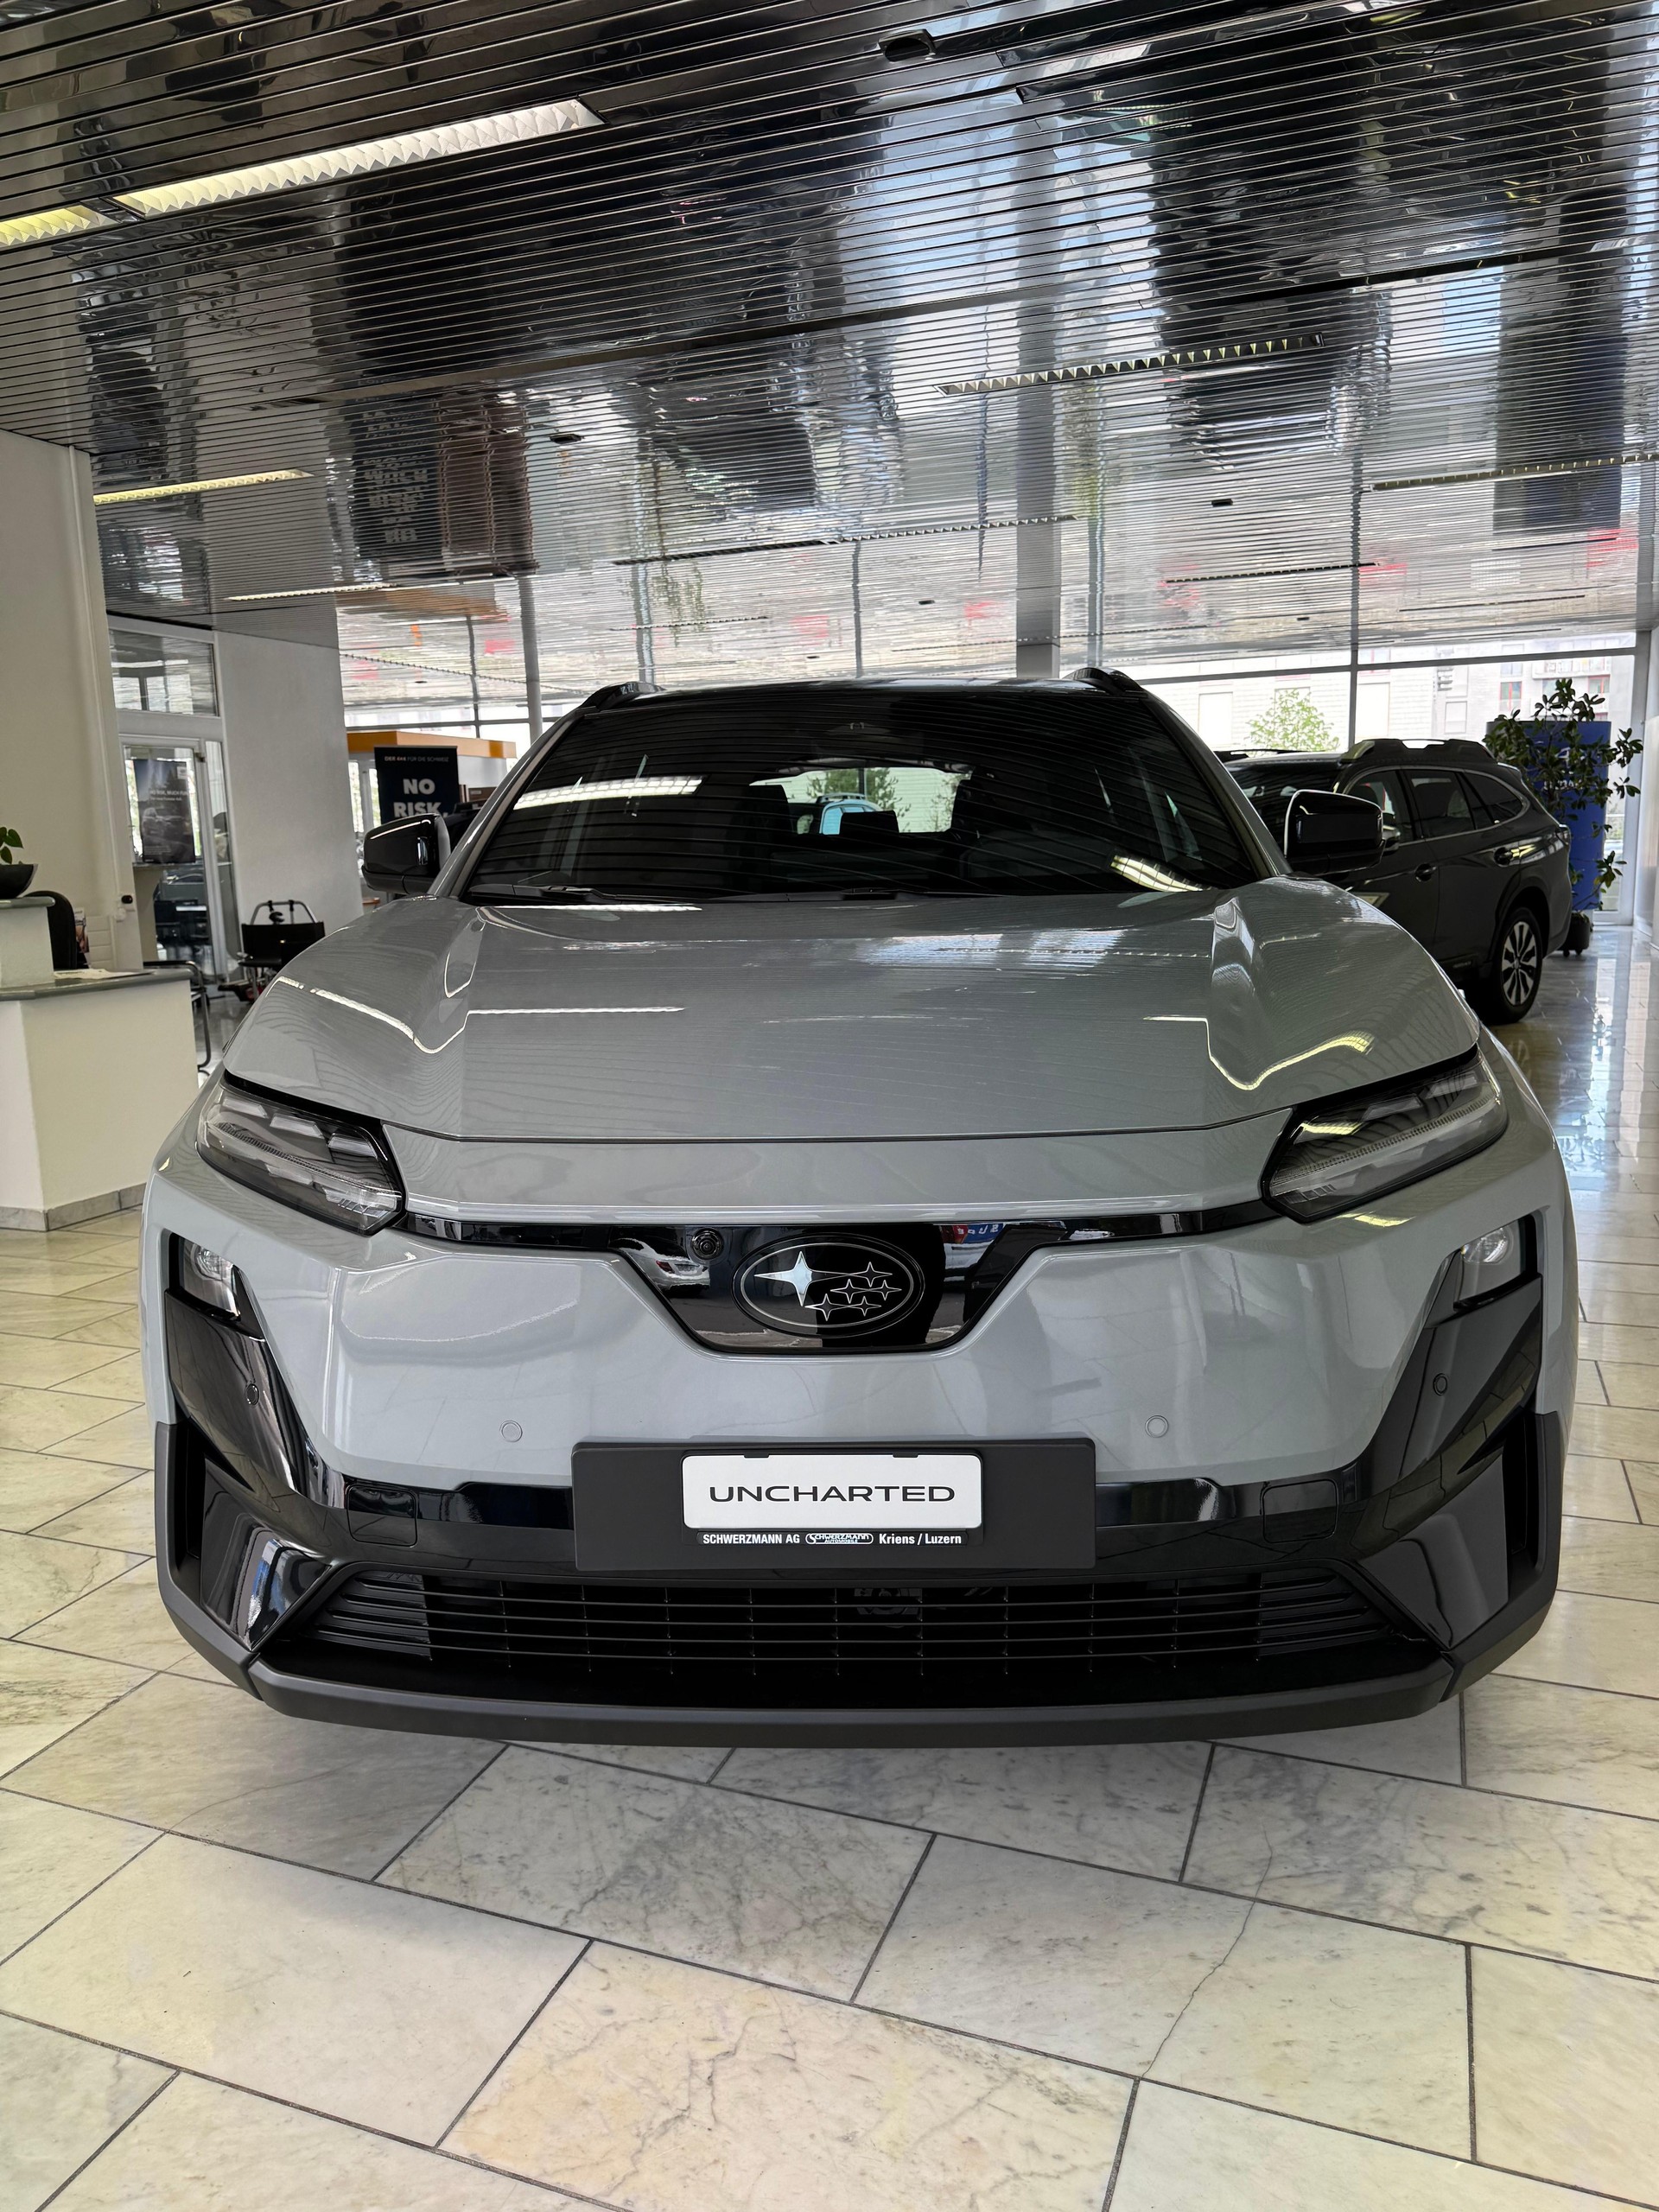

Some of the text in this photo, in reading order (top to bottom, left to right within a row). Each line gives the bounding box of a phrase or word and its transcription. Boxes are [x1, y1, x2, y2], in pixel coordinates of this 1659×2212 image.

[403, 779, 435, 795] NO
[709, 1485, 955, 1502] UNCHARTED
[702, 1533, 962, 1545] SCHWERZMANN AG Kriens / Luzern
